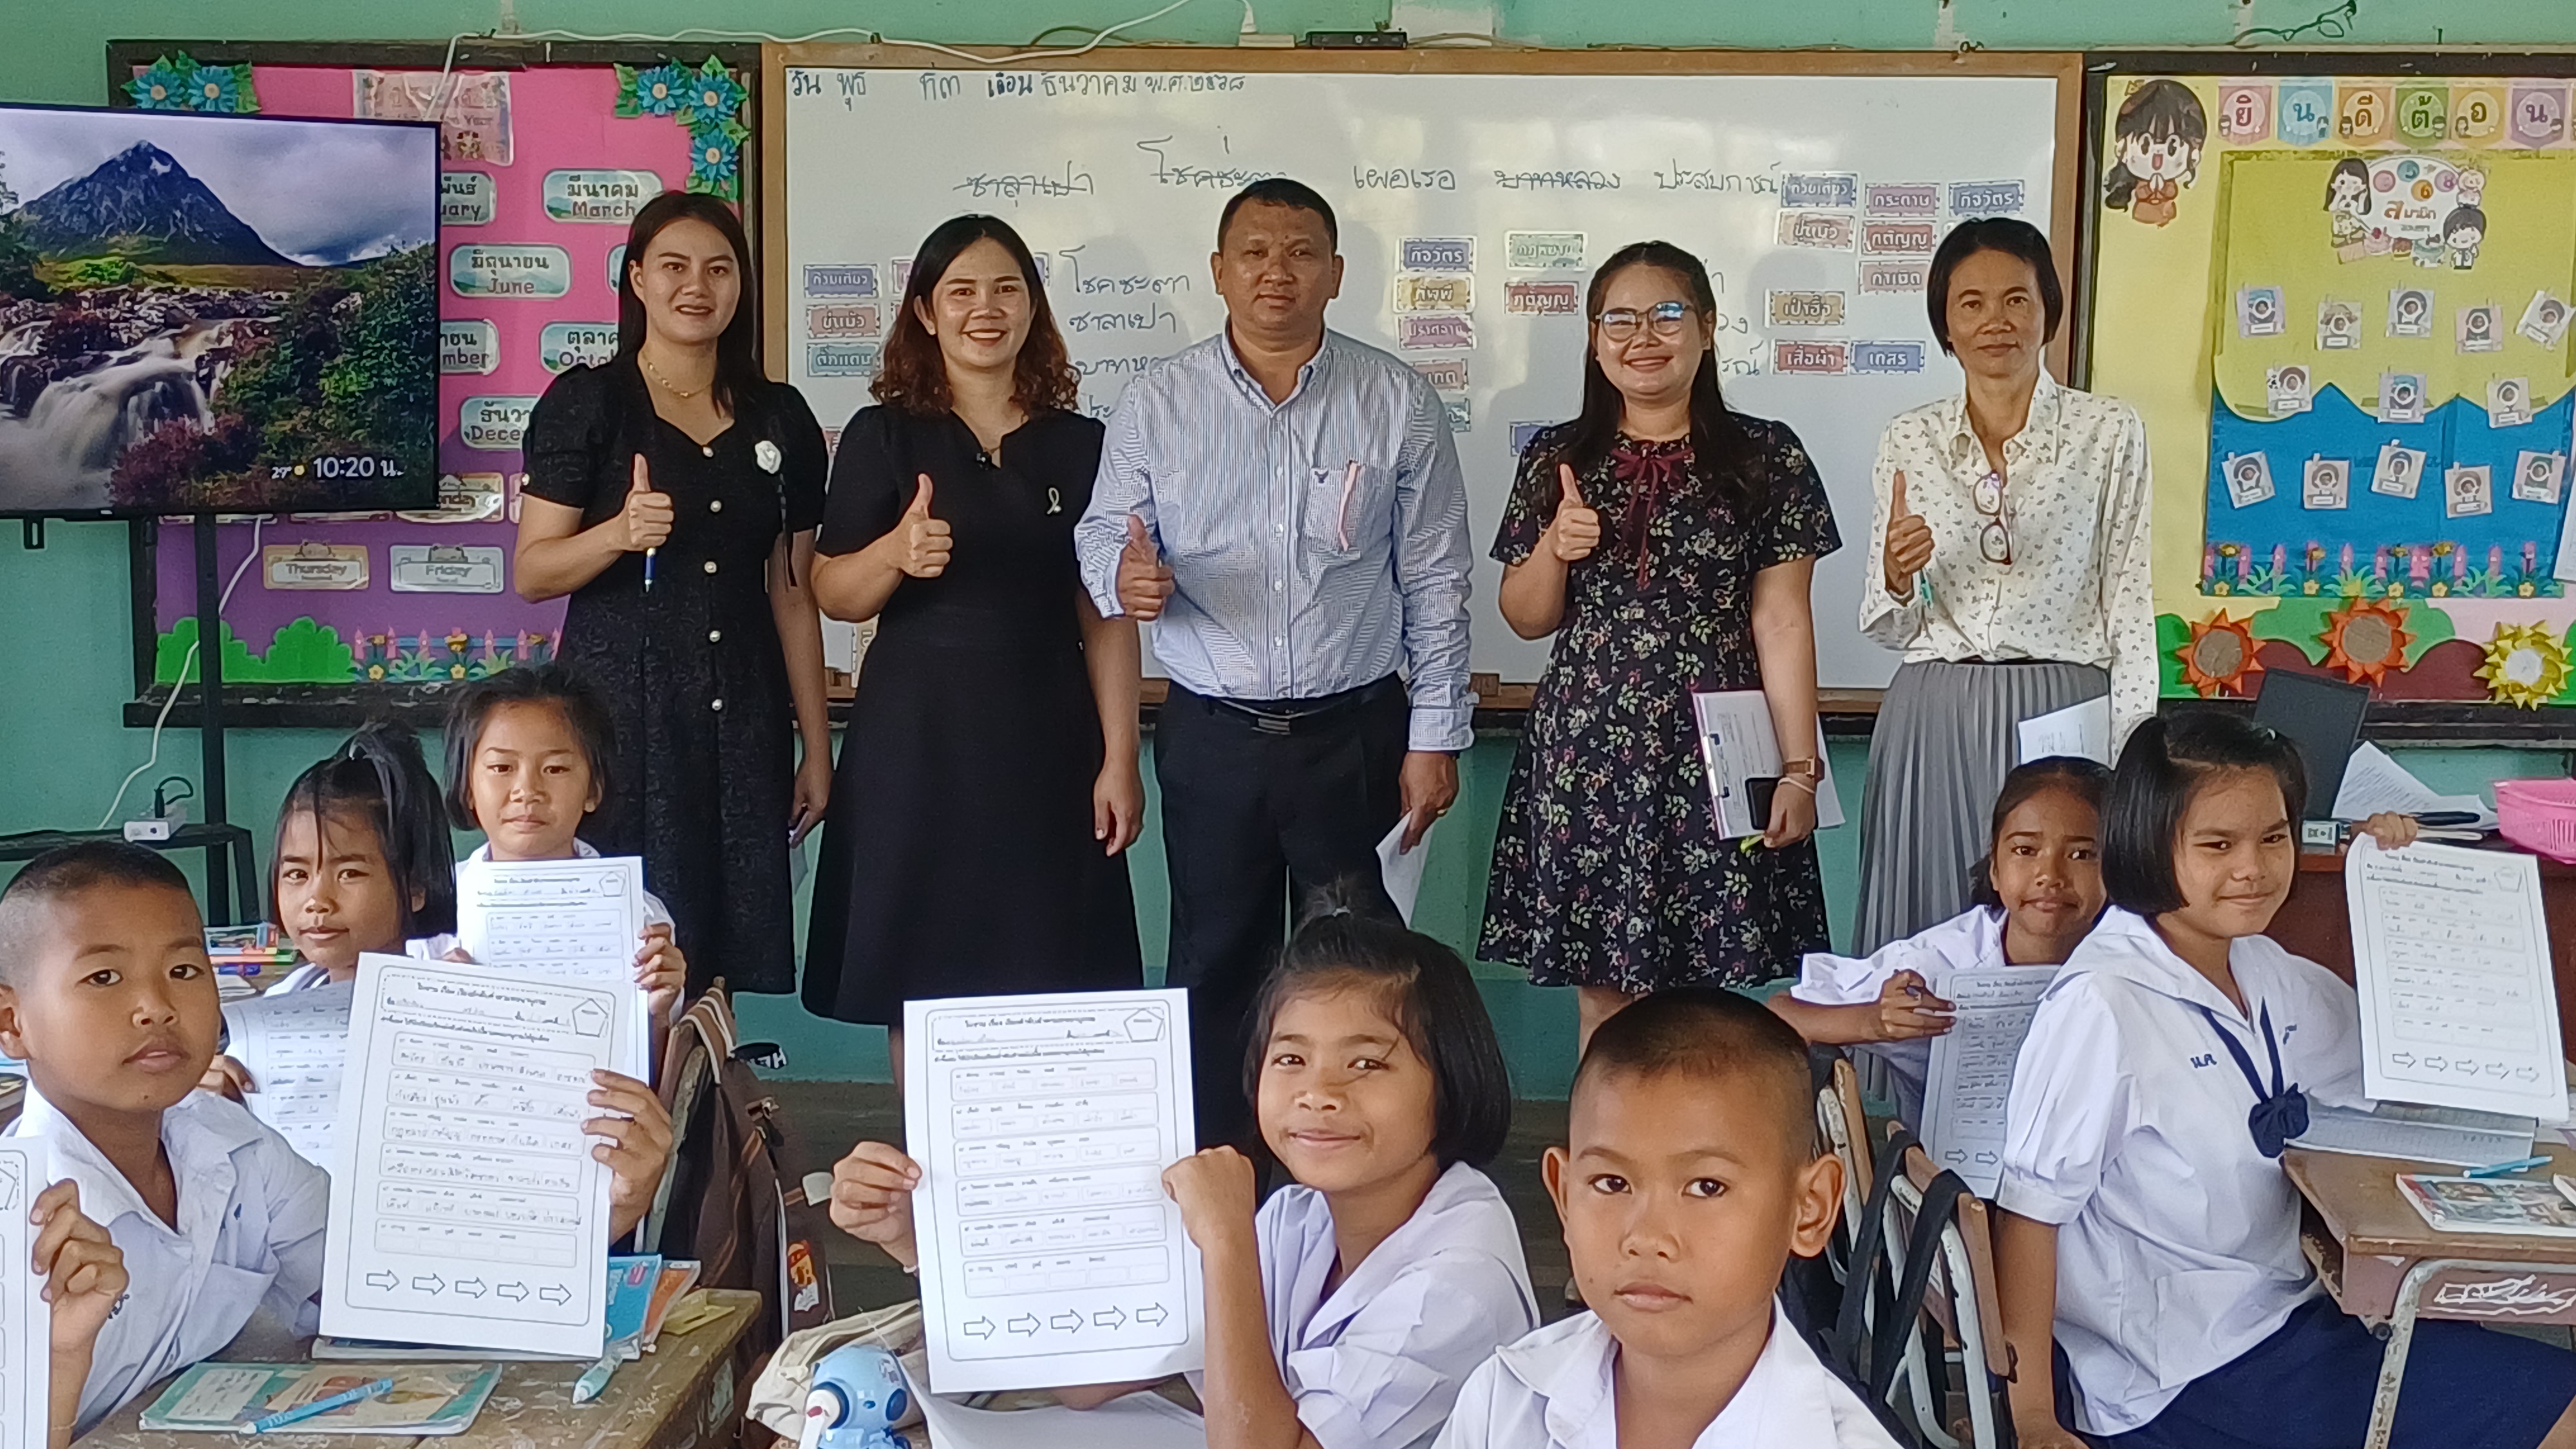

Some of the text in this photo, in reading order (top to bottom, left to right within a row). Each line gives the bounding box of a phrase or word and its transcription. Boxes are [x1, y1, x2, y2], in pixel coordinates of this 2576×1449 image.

[788, 70, 822, 97] วัน
[837, 71, 867, 112] พุธ
[1040, 71, 1137, 97] ธันวาคม
[567, 174, 639, 198] มีนาคม
[573, 200, 636, 218] March
[1873, 193, 1931, 208] กระดาษ
[1959, 191, 2015, 209] กิจวัตร
[1059, 244, 1190, 295] โชคชะตา
[487, 278, 535, 294] June
[470, 425, 521, 441] Dece
[313, 456, 375, 478] 10:20
